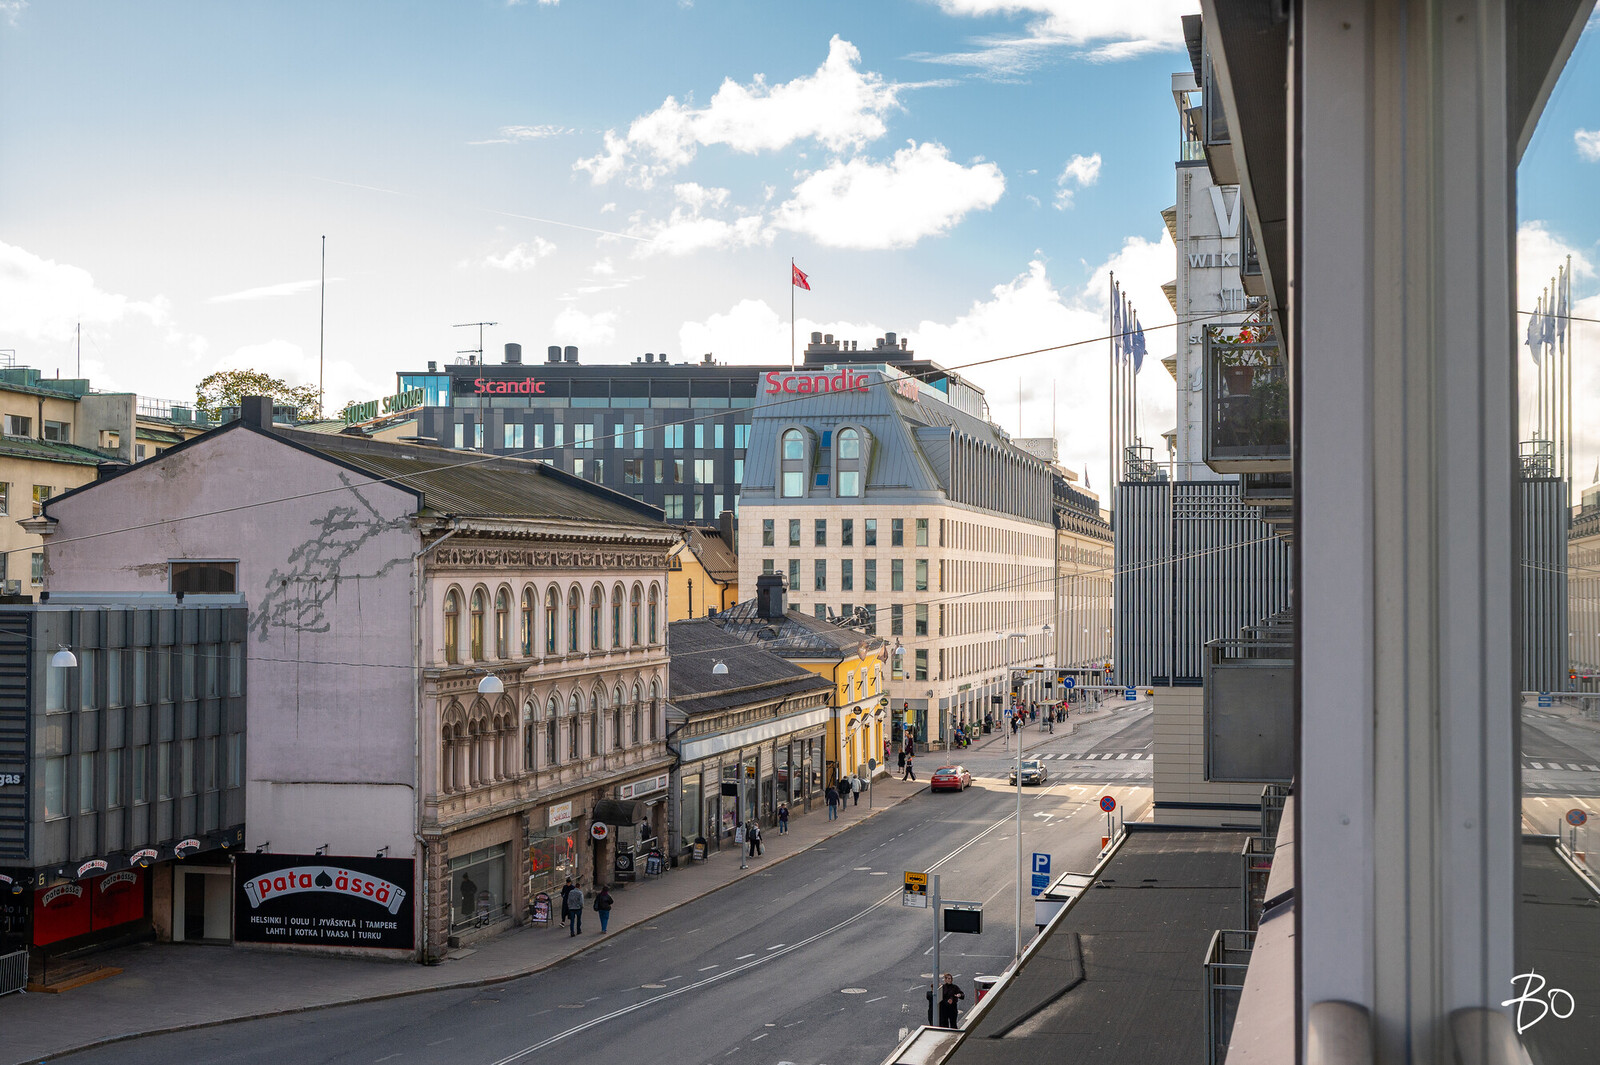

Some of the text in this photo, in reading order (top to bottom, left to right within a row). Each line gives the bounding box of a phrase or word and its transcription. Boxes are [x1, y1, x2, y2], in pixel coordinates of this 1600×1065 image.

[474, 377, 545, 394] Scandic
[766, 368, 869, 394] Scandic
[345, 388, 425, 427] TURUN SANOMAT
[1035, 854, 1048, 871] P
[258, 870, 391, 903] pata ässä
[250, 916, 398, 929] HELSINKI OULU JYVÄSKYLÄ TAMPERE
[265, 927, 382, 940] LAHTI KOTKA VAASA TURKU
